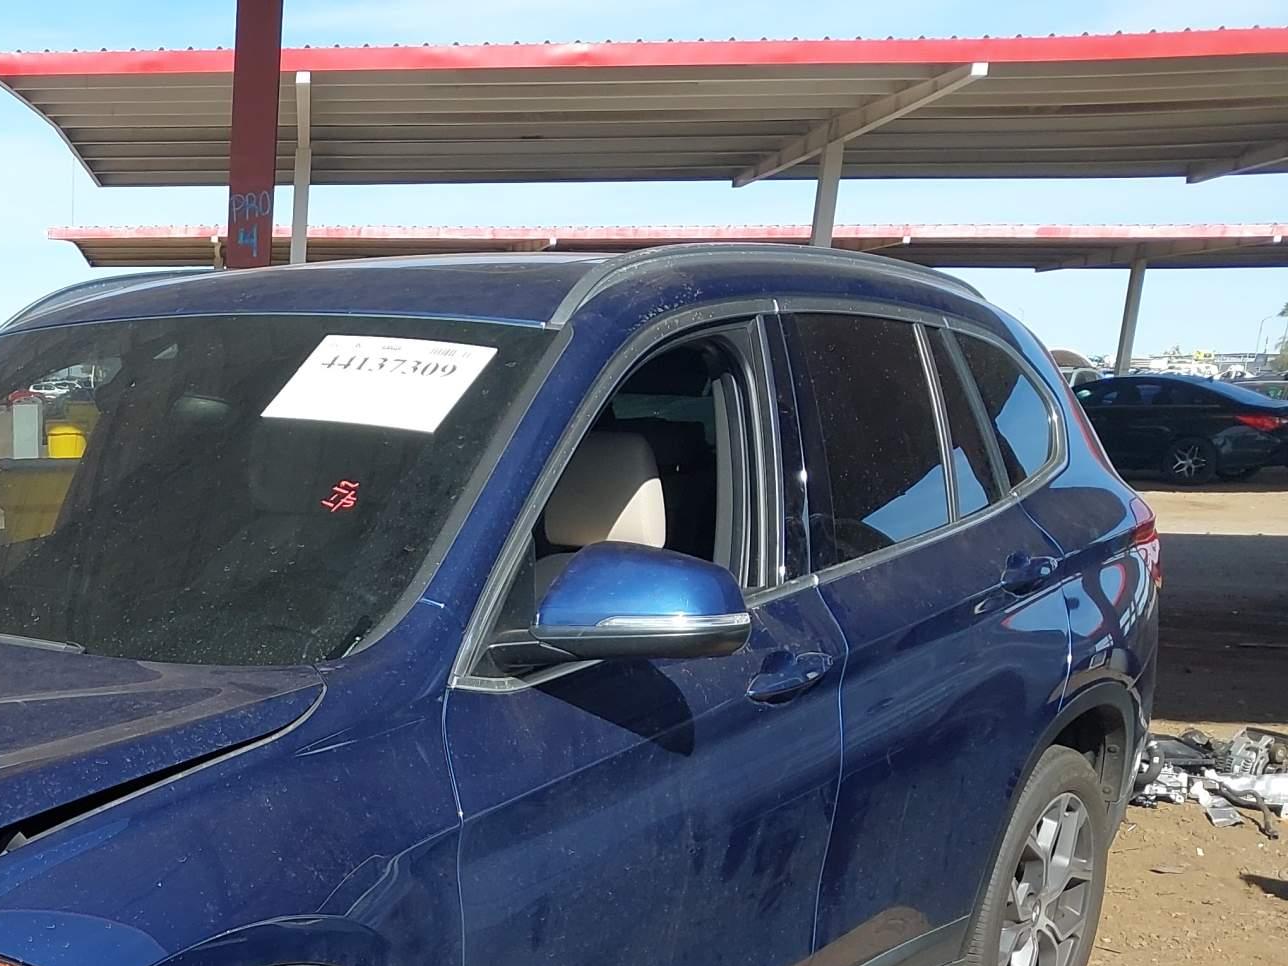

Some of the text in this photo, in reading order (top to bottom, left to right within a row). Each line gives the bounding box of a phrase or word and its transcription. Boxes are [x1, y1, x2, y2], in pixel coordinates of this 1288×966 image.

[231, 190, 271, 224] PRO
[238, 223, 258, 257] 4
[321, 354, 458, 378] 44137309
